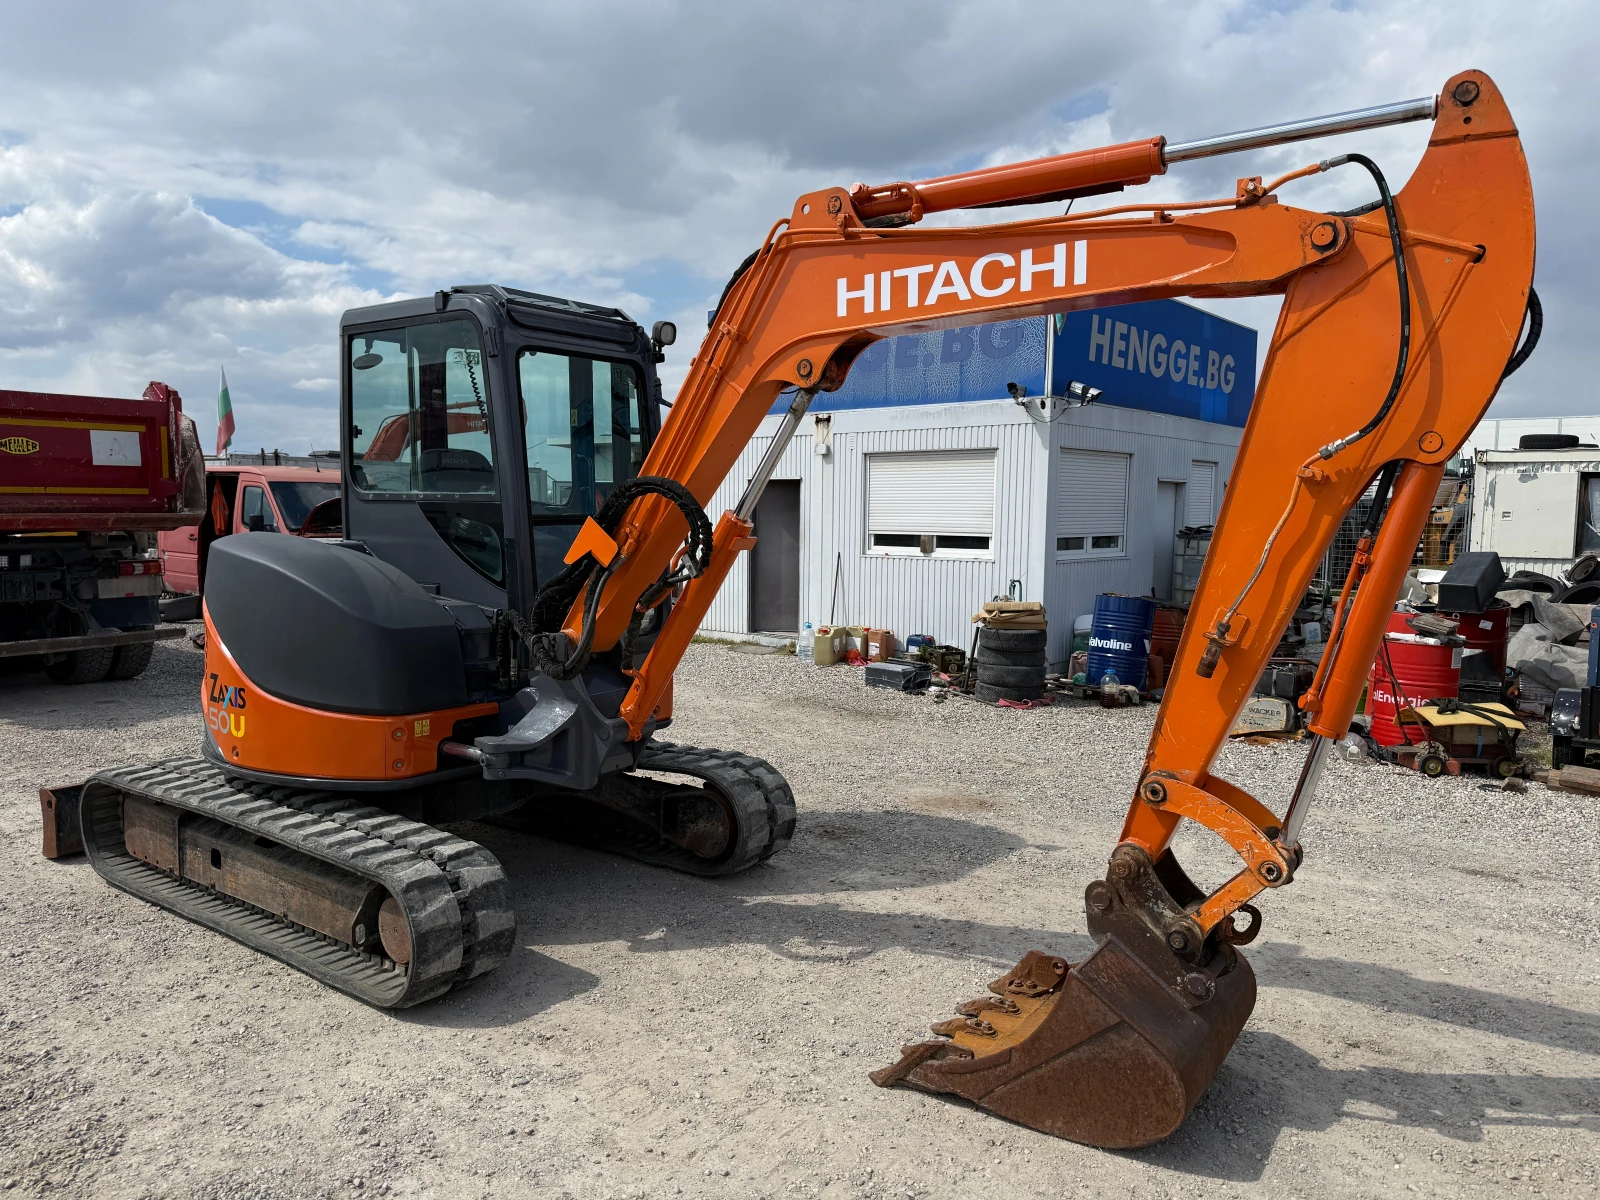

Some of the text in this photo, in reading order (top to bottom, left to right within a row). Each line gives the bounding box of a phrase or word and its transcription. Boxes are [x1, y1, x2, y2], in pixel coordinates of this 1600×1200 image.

[836, 239, 1088, 317] HITACHI
[1088, 314, 1236, 394] HENGGE.BG
[0, 438, 38, 452] MEILLER
[209, 673, 247, 709] ZAXIS
[209, 706, 245, 738] 50U
[1248, 706, 1281, 718] WACKER
